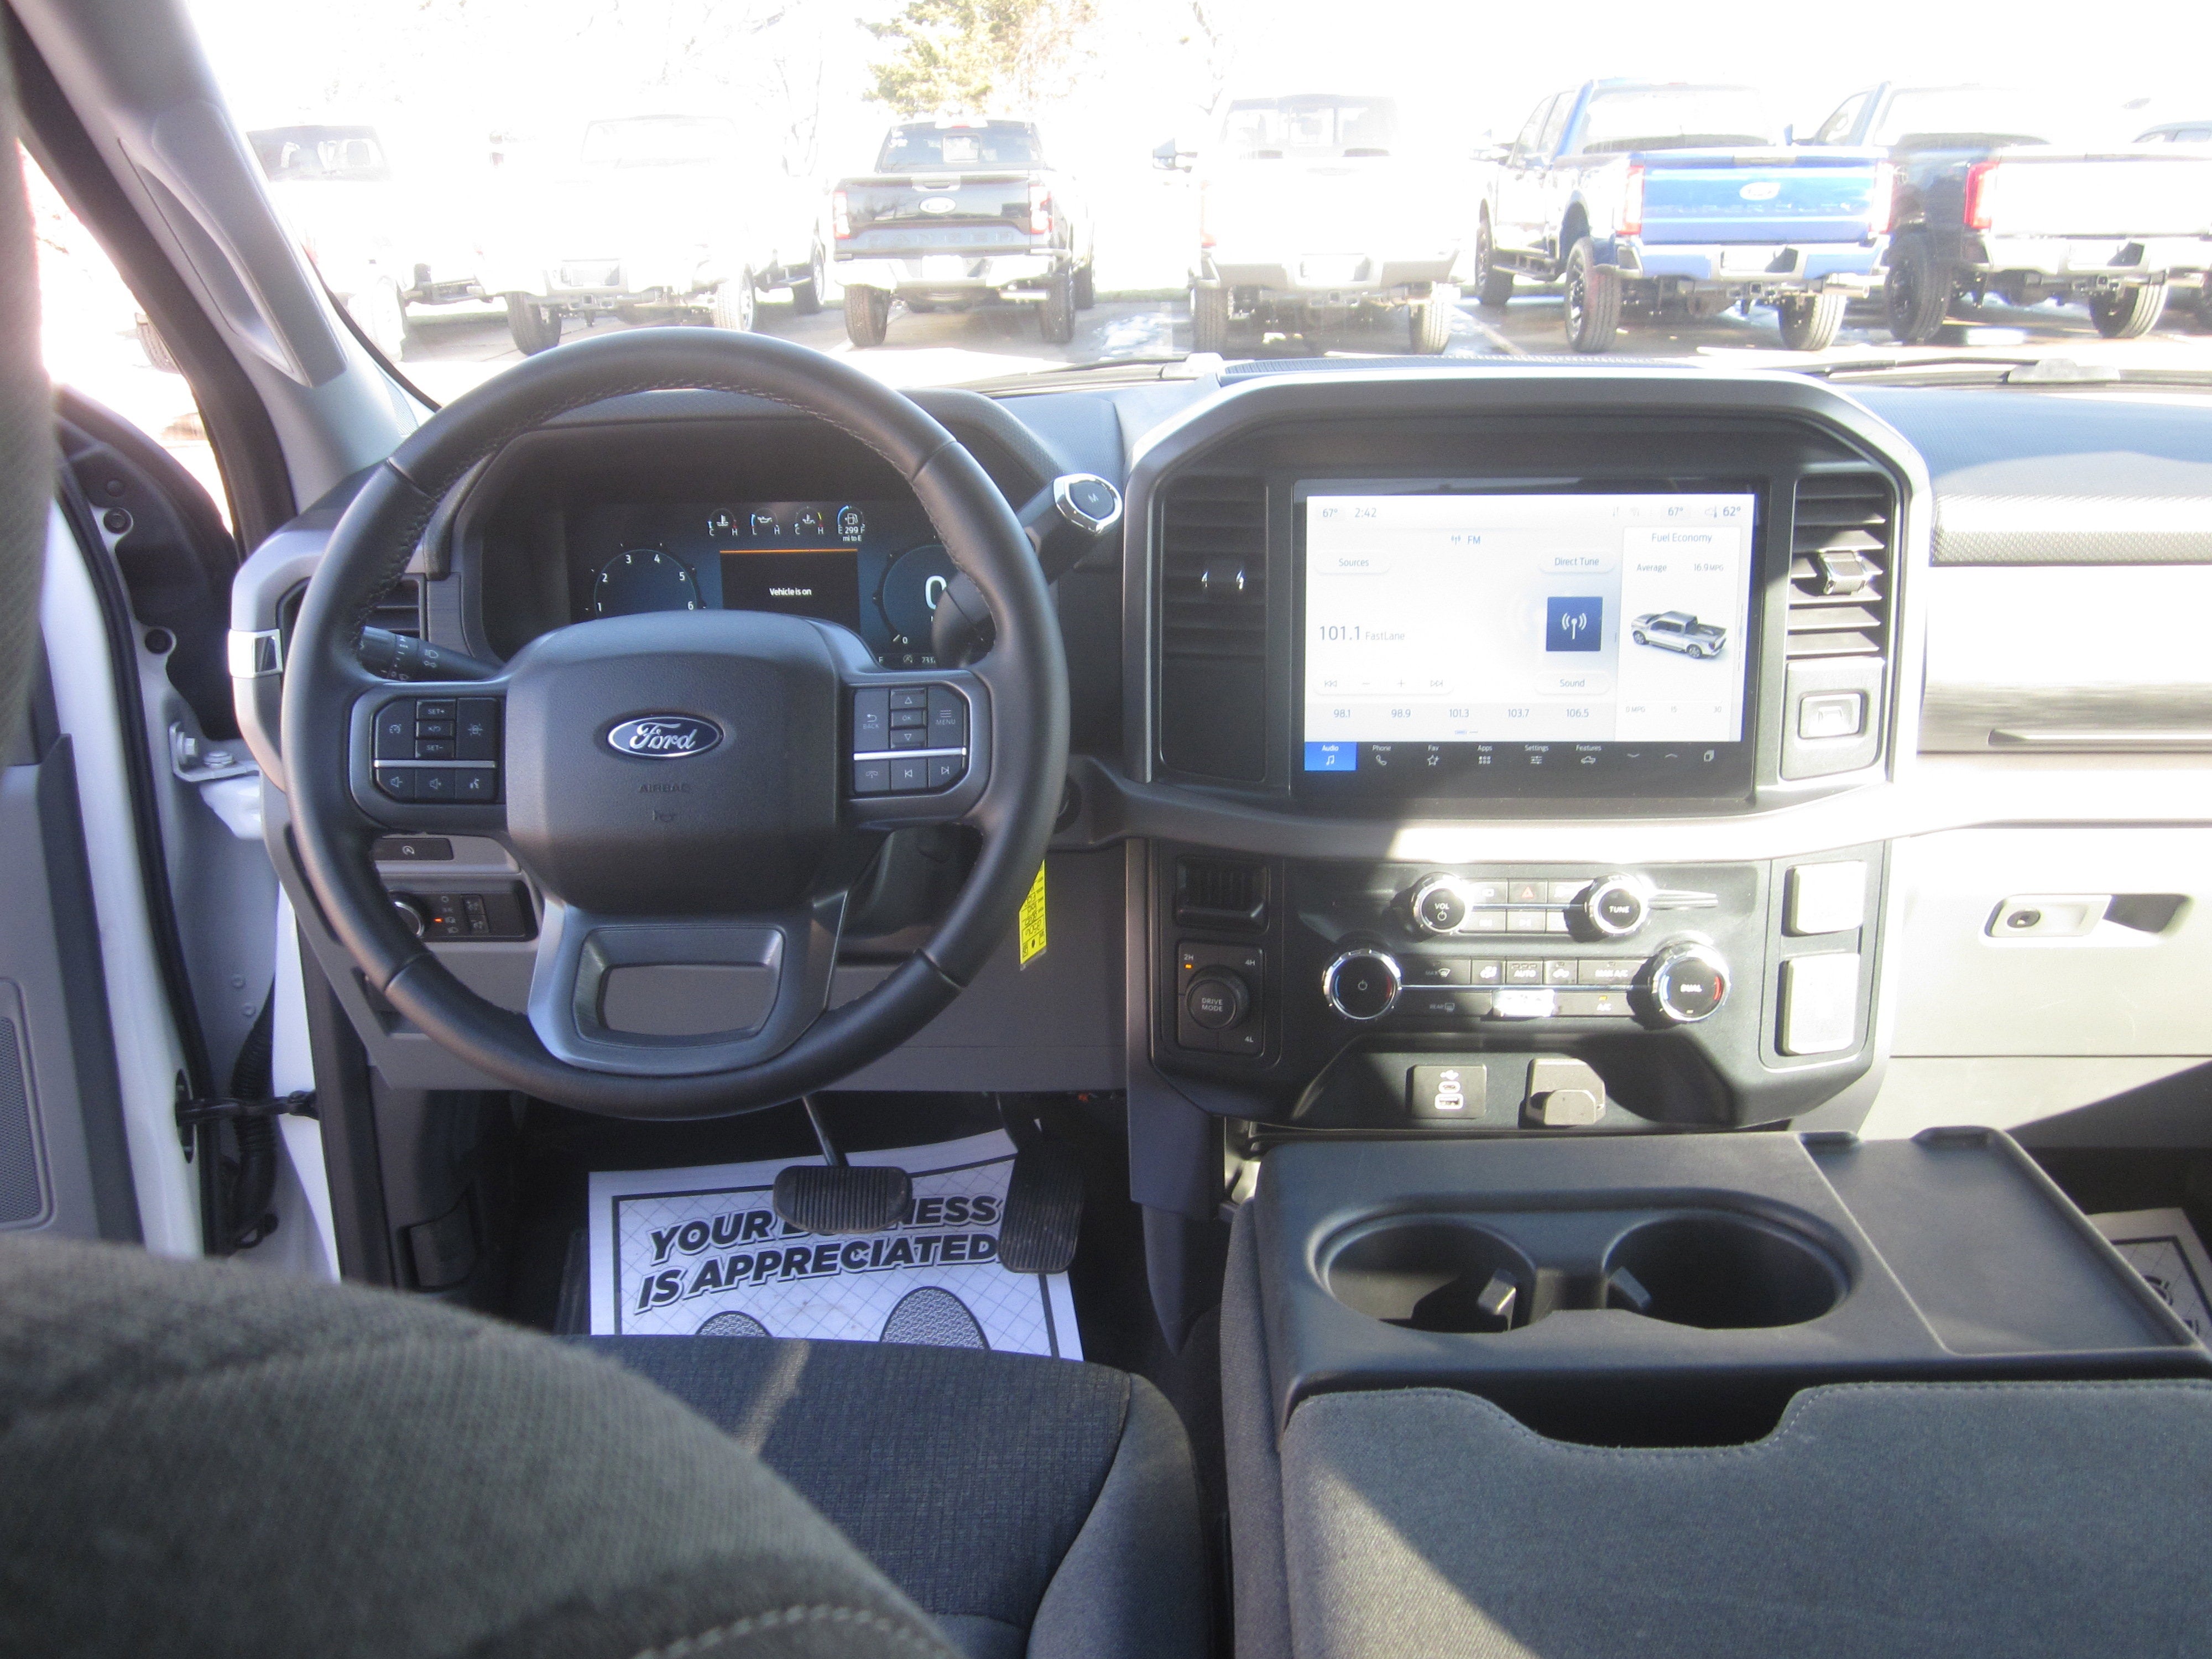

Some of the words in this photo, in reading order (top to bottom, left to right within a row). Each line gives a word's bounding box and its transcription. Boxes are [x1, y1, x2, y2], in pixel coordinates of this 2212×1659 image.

[1322, 508, 1338, 518] 67°
[1354, 508, 1377, 518] 2:42
[1668, 507, 1684, 517] 67°
[1723, 506, 1741, 517] 62°
[1468, 535, 1481, 545] FM
[1651, 533, 1670, 542] Fuel
[1672, 533, 1713, 544] Economy
[625, 555, 632, 564] 3
[654, 554, 660, 564] 4
[1338, 558, 1369, 567] Sources
[1554, 557, 1578, 566] Direct
[1580, 557, 1599, 566] Tune
[1636, 564, 1667, 573] Average
[602, 573, 608, 582] 2
[679, 571, 685, 581] 5
[769, 587, 795, 596] Vehicle
[795, 587, 801, 596] is
[597, 602, 602, 612] 1
[687, 601, 694, 611] 6
[1319, 625, 1361, 641] 101.1
[1365, 631, 1405, 640] FastLane
[1559, 679, 1585, 688] Sound
[1333, 708, 1352, 718] 98.1
[1391, 708, 1411, 718] 98.9
[1449, 708, 1469, 718] 101.3
[1507, 708, 1530, 718] 103.7
[1566, 708, 1590, 718] 106.5
[629, 721, 698, 750] Ford
[1477, 744, 1493, 753] Apps
[1525, 744, 1550, 753] Settings
[1434, 902, 1450, 910] VOL
[1609, 905, 1630, 914] TUNE
[1514, 969, 1537, 978] AUTO
[1201, 997, 1224, 1006] DRIVE
[1201, 1004, 1224, 1013] MODE
[649, 1209, 775, 1263] YOUR
[635, 1267, 686, 1312] IS
[687, 1232, 1000, 1297] APPRECIATED
